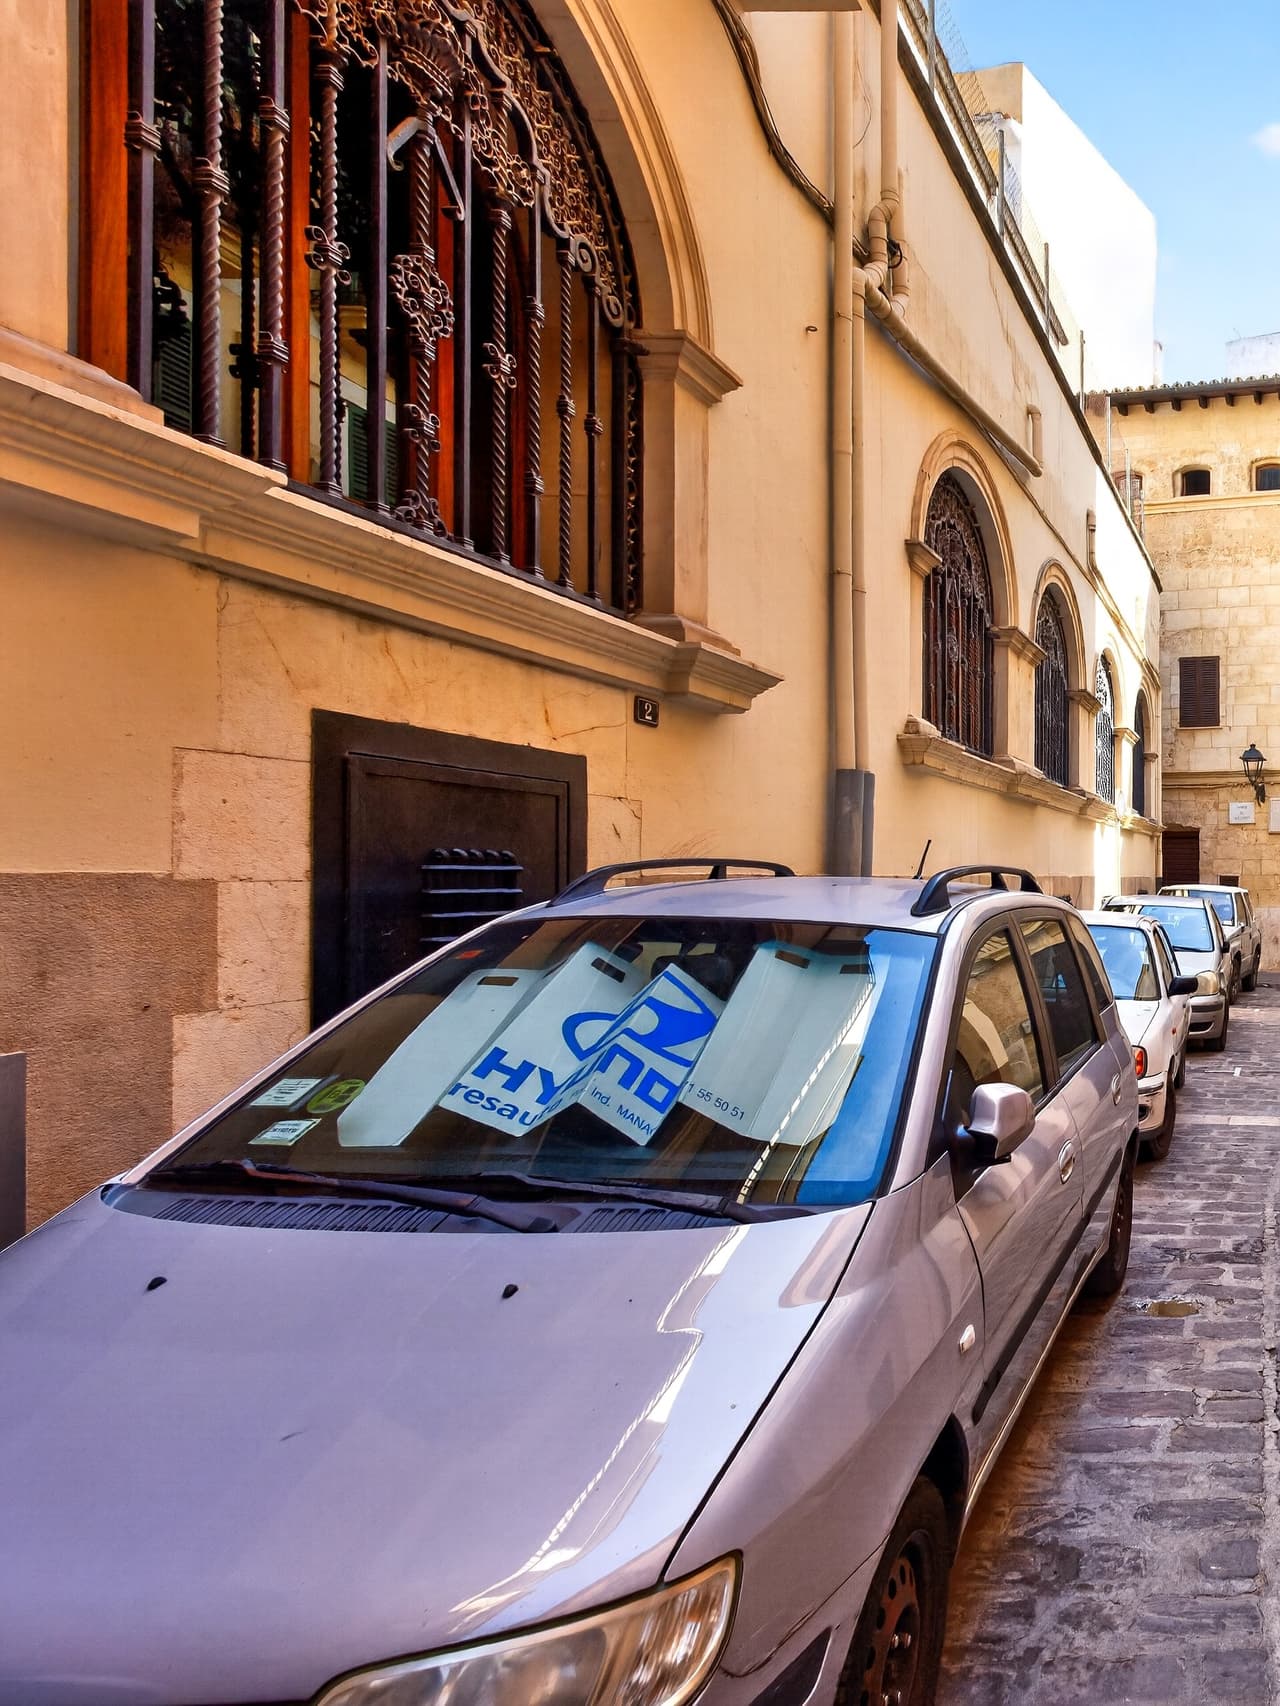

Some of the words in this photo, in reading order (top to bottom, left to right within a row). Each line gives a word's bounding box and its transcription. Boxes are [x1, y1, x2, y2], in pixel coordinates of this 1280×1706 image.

[644, 702, 653, 721] 2
[591, 1087, 612, 1107] Ind.
[697, 1088, 713, 1102] 55
[714, 1097, 730, 1112] 50
[730, 1106, 745, 1120] 51
